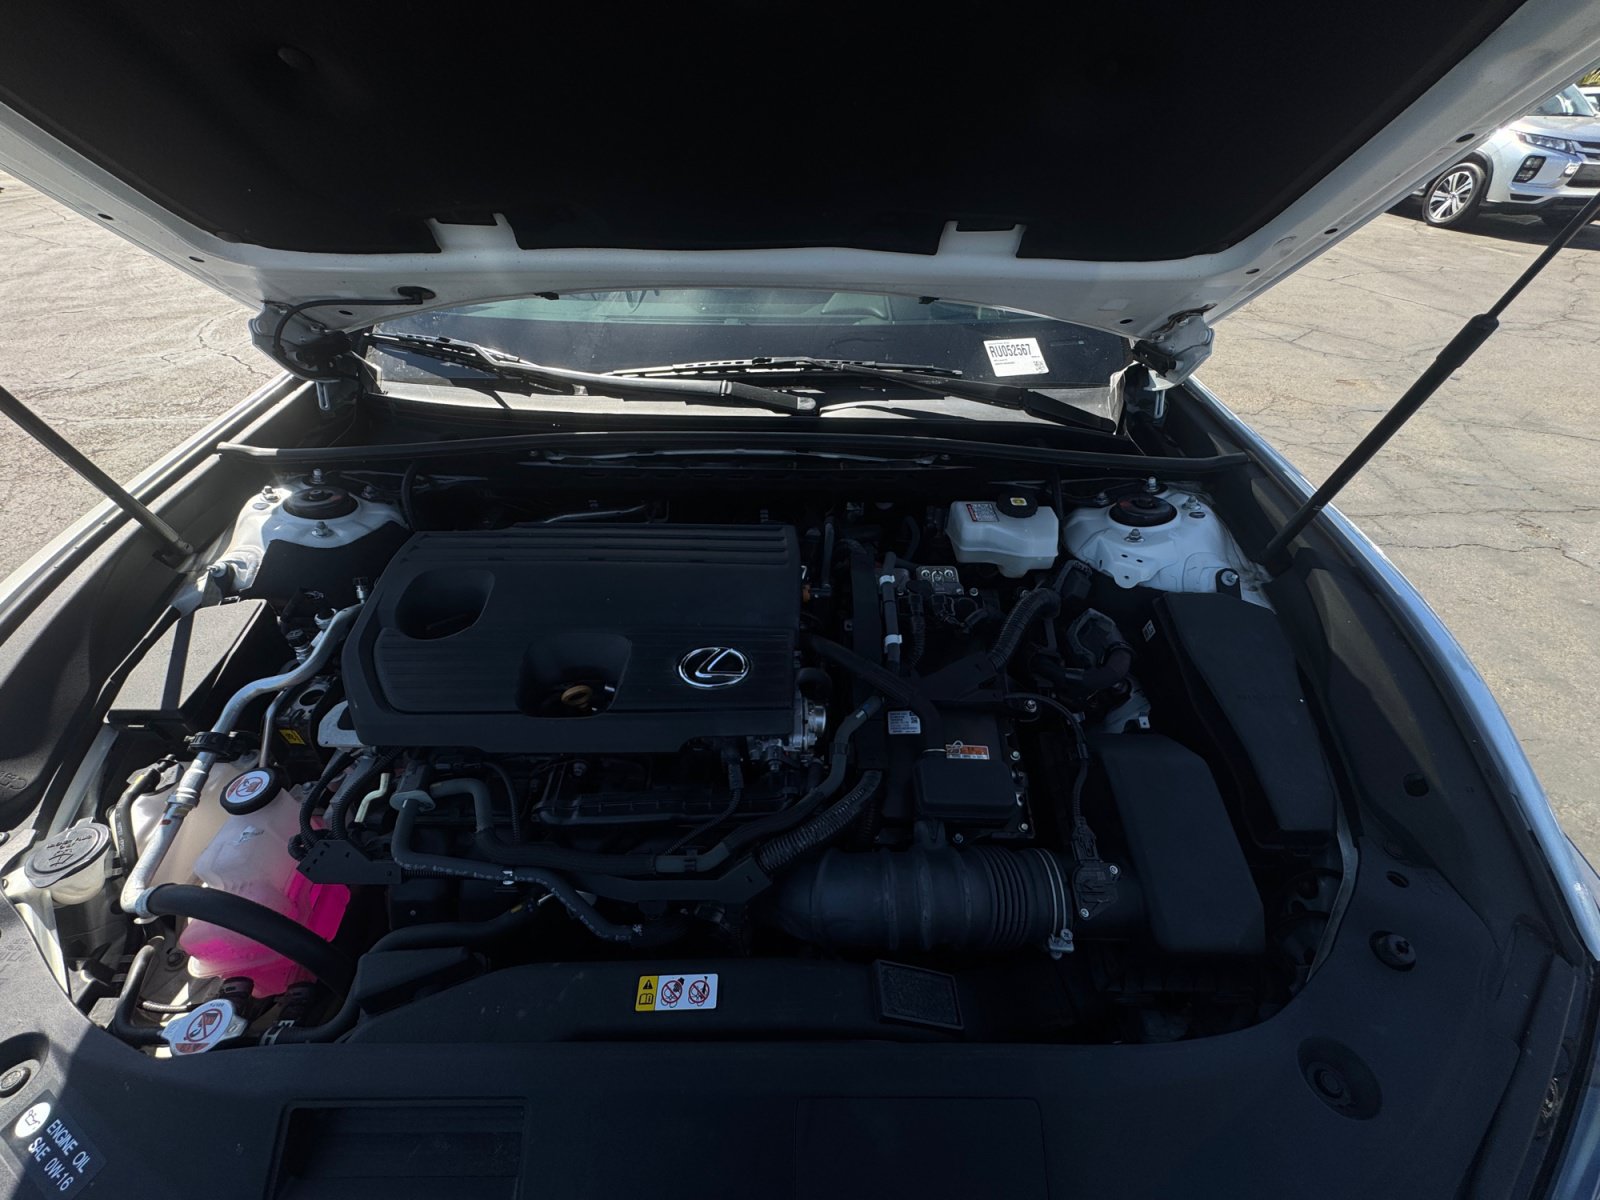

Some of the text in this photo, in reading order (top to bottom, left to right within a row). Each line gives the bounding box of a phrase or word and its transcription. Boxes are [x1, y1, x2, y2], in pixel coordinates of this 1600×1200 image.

[989, 344, 1031, 358] RU052567
[28, 1136, 51, 1162] SAE
[46, 1119, 91, 1174] ENGINE OIL
